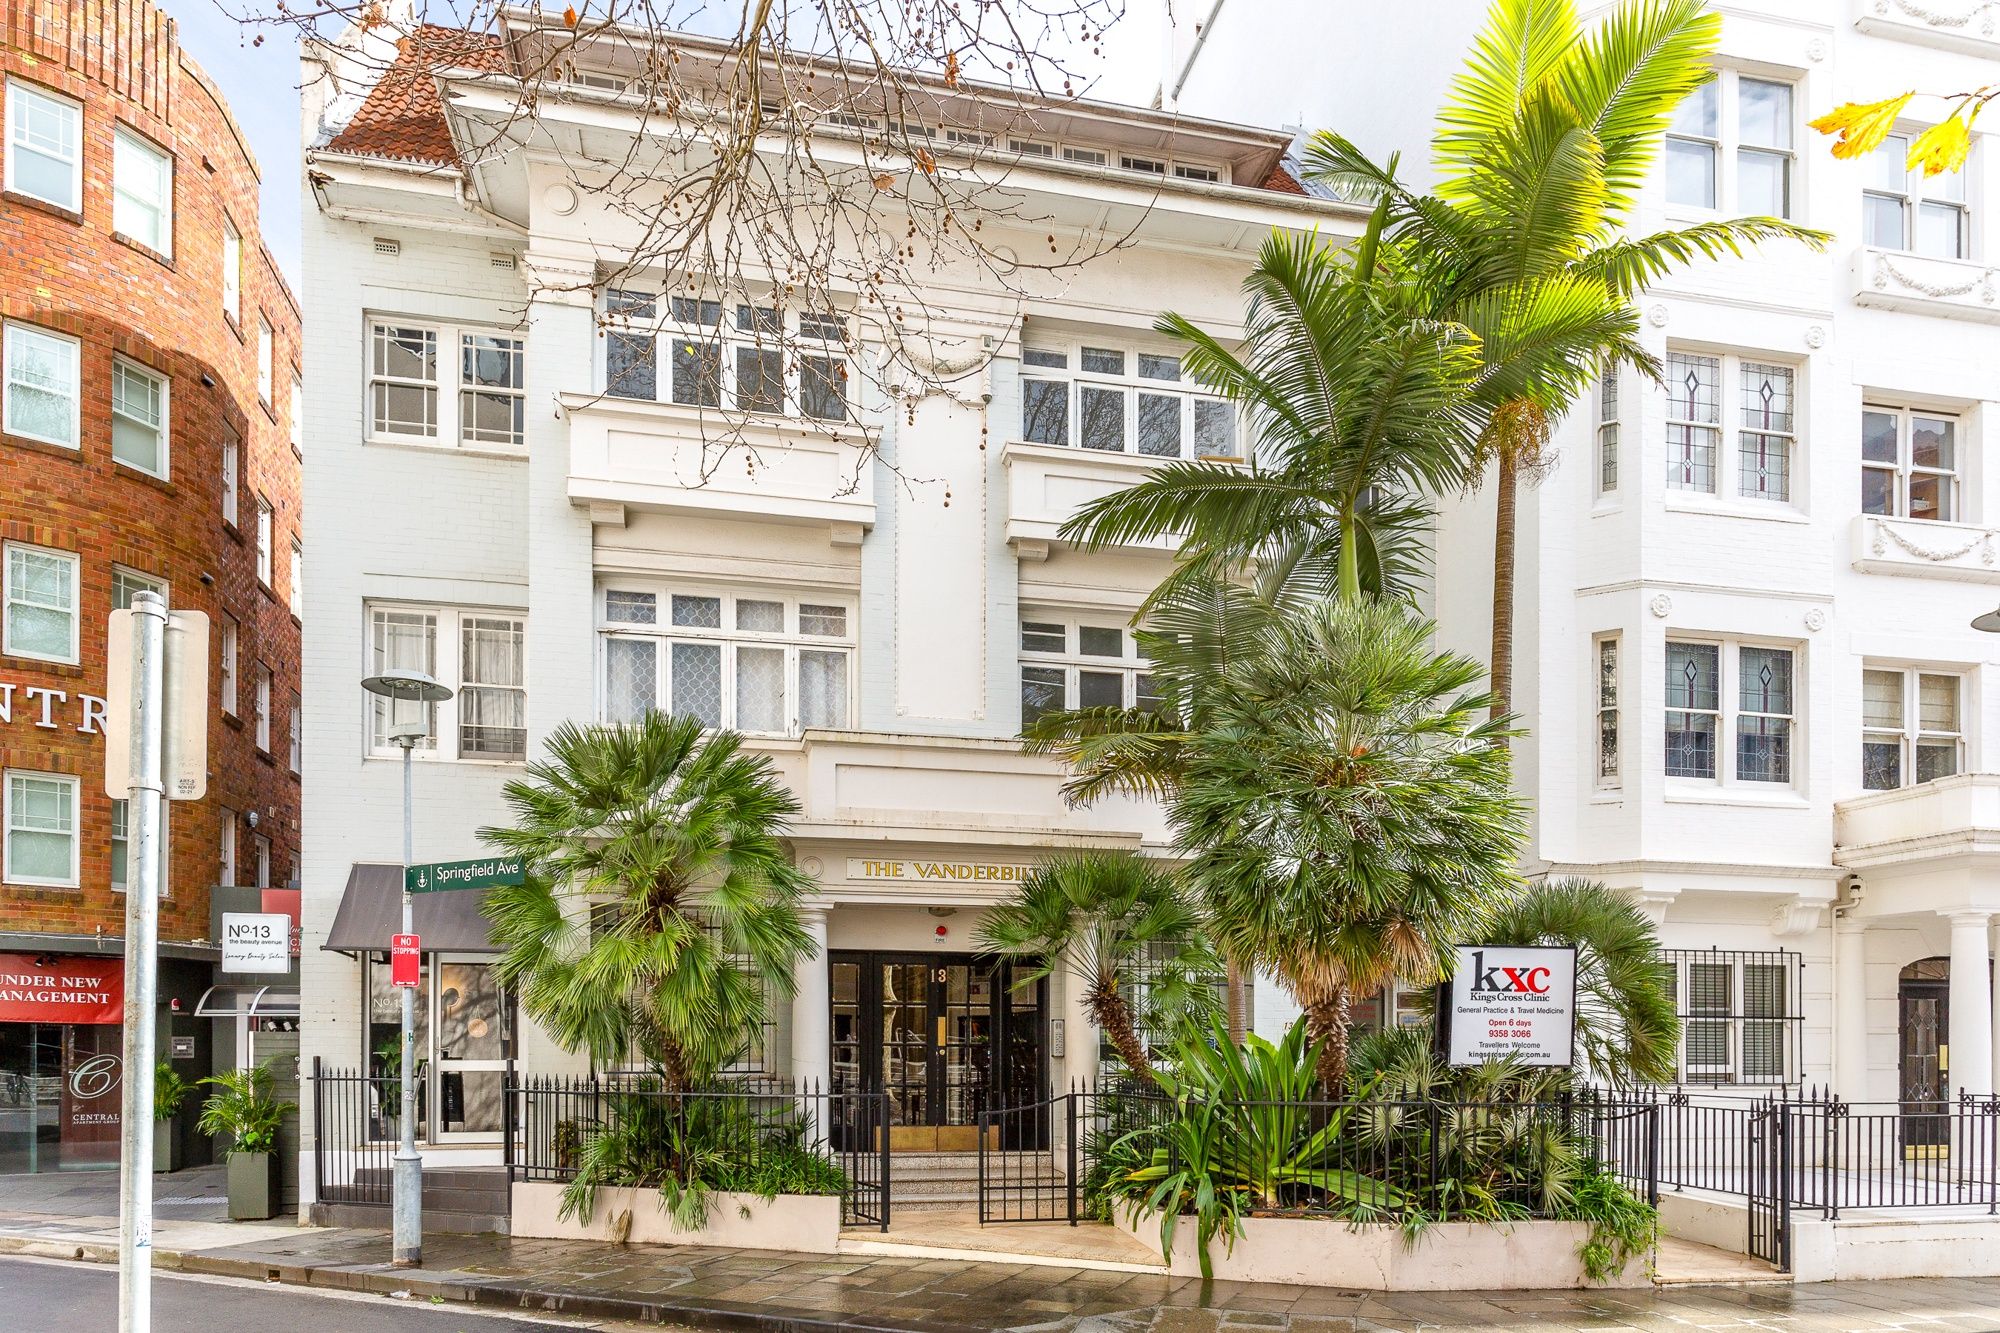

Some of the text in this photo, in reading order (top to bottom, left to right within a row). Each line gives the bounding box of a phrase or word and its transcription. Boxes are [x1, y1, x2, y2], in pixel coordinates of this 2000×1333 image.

[437, 862, 519, 883] Springfield Ave
[862, 861, 904, 877] THE
[400, 937, 411, 946] NO
[931, 969, 946, 983] 13
[61, 977, 101, 989] NEW
[1470, 993, 1550, 1003] Kings Cross Clinic
[1488, 1019, 1507, 1027] Open
[1516, 1019, 1532, 1027] days
[1488, 1030, 1532, 1038] 9358 3066
[1468, 1051, 1551, 1059] kingscrosscc.com.au
[72, 1113, 120, 1121] CENTRAL
